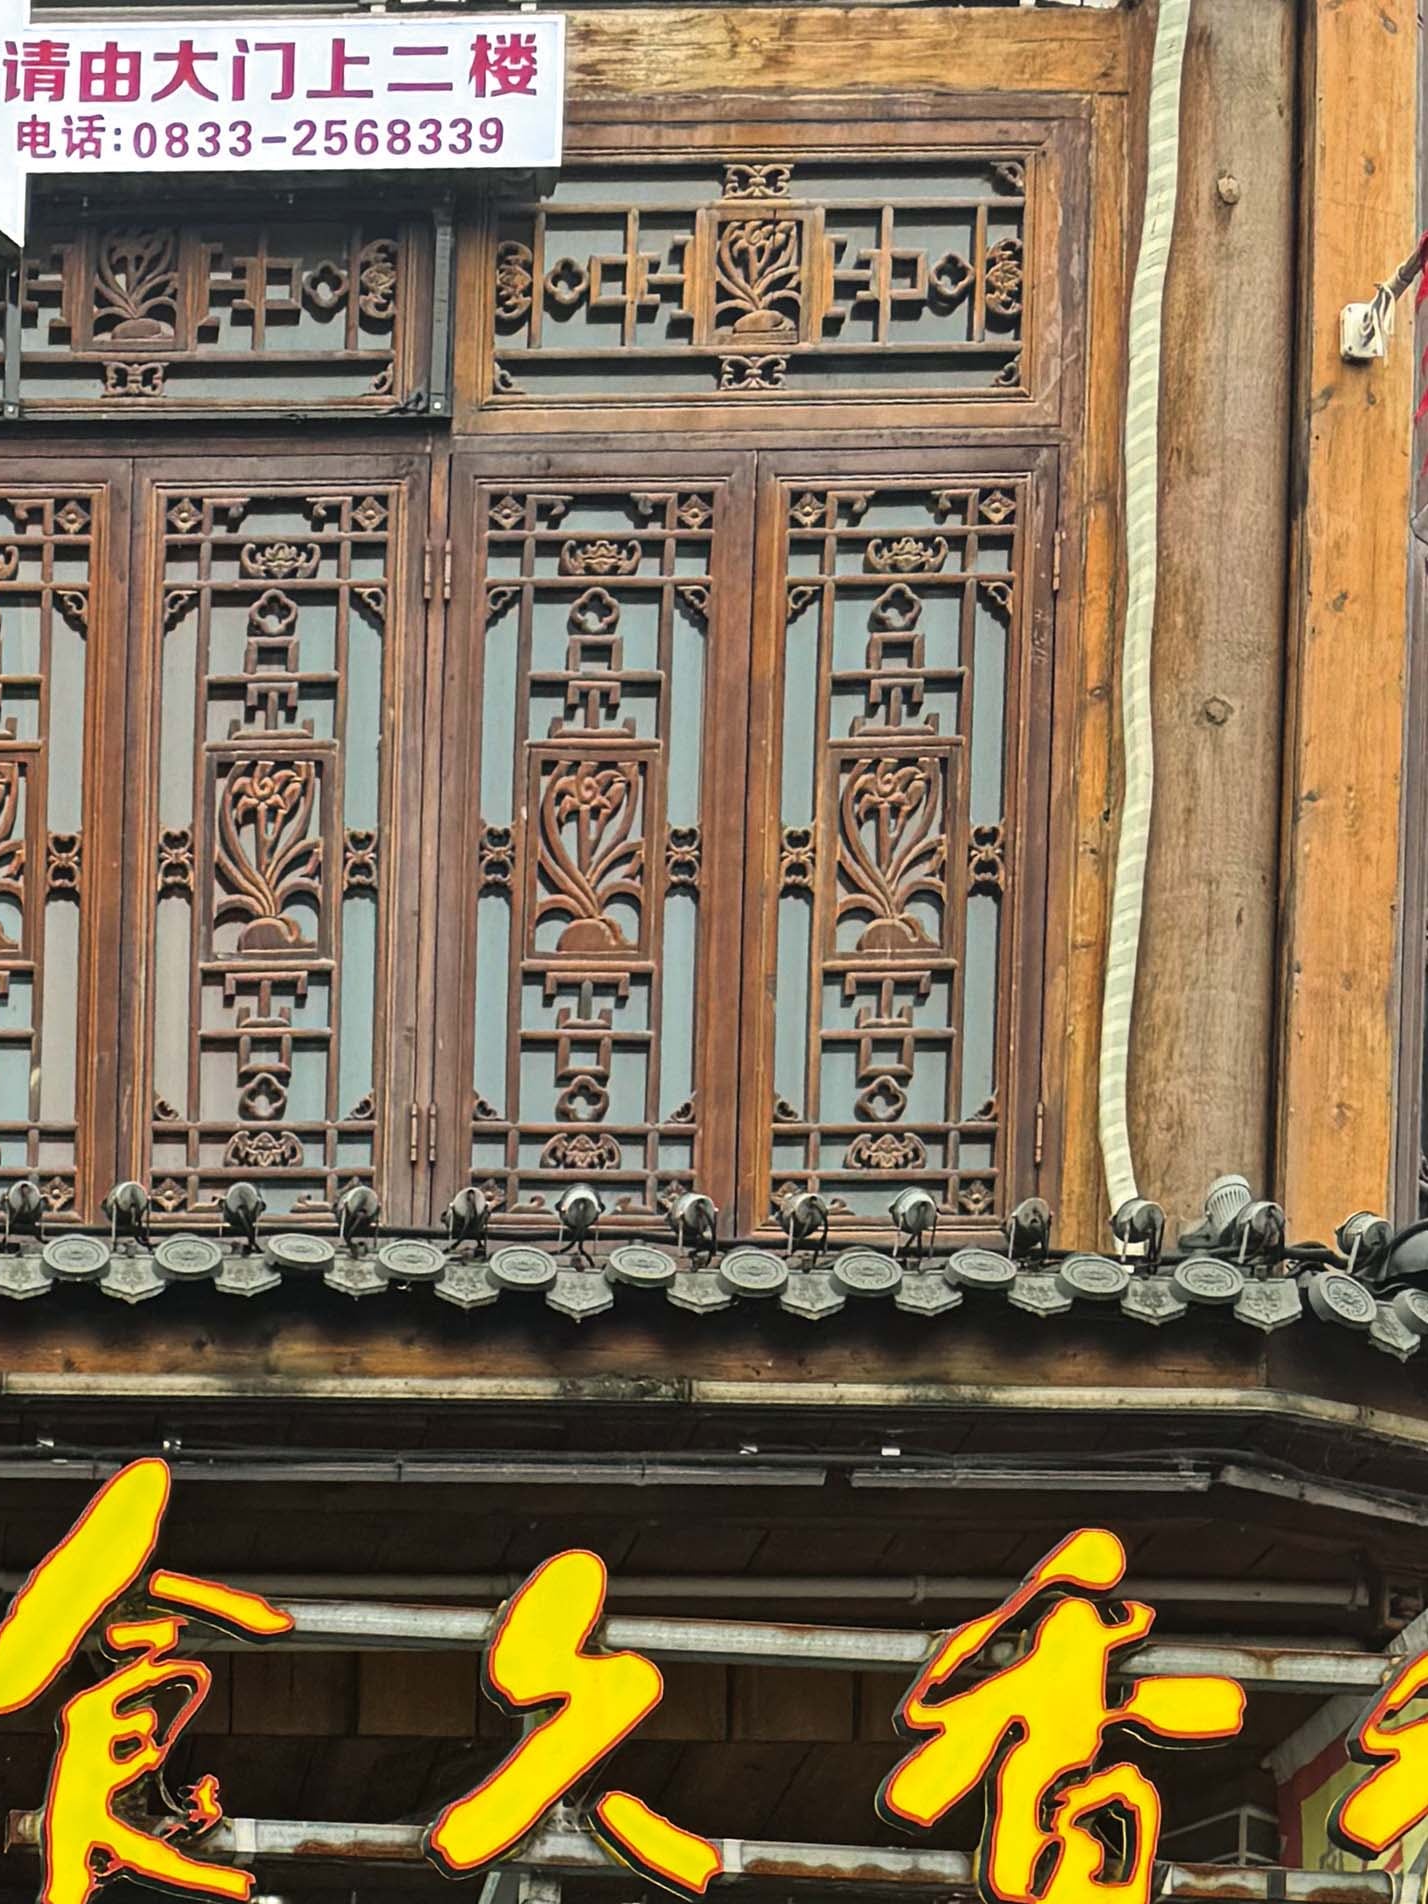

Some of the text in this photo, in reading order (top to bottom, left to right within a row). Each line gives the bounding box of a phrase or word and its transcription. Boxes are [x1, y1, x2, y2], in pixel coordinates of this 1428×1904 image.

[3, 32, 540, 103] 请由大门上二楼
[16, 114, 505, 160] 电话:0833-2568339
